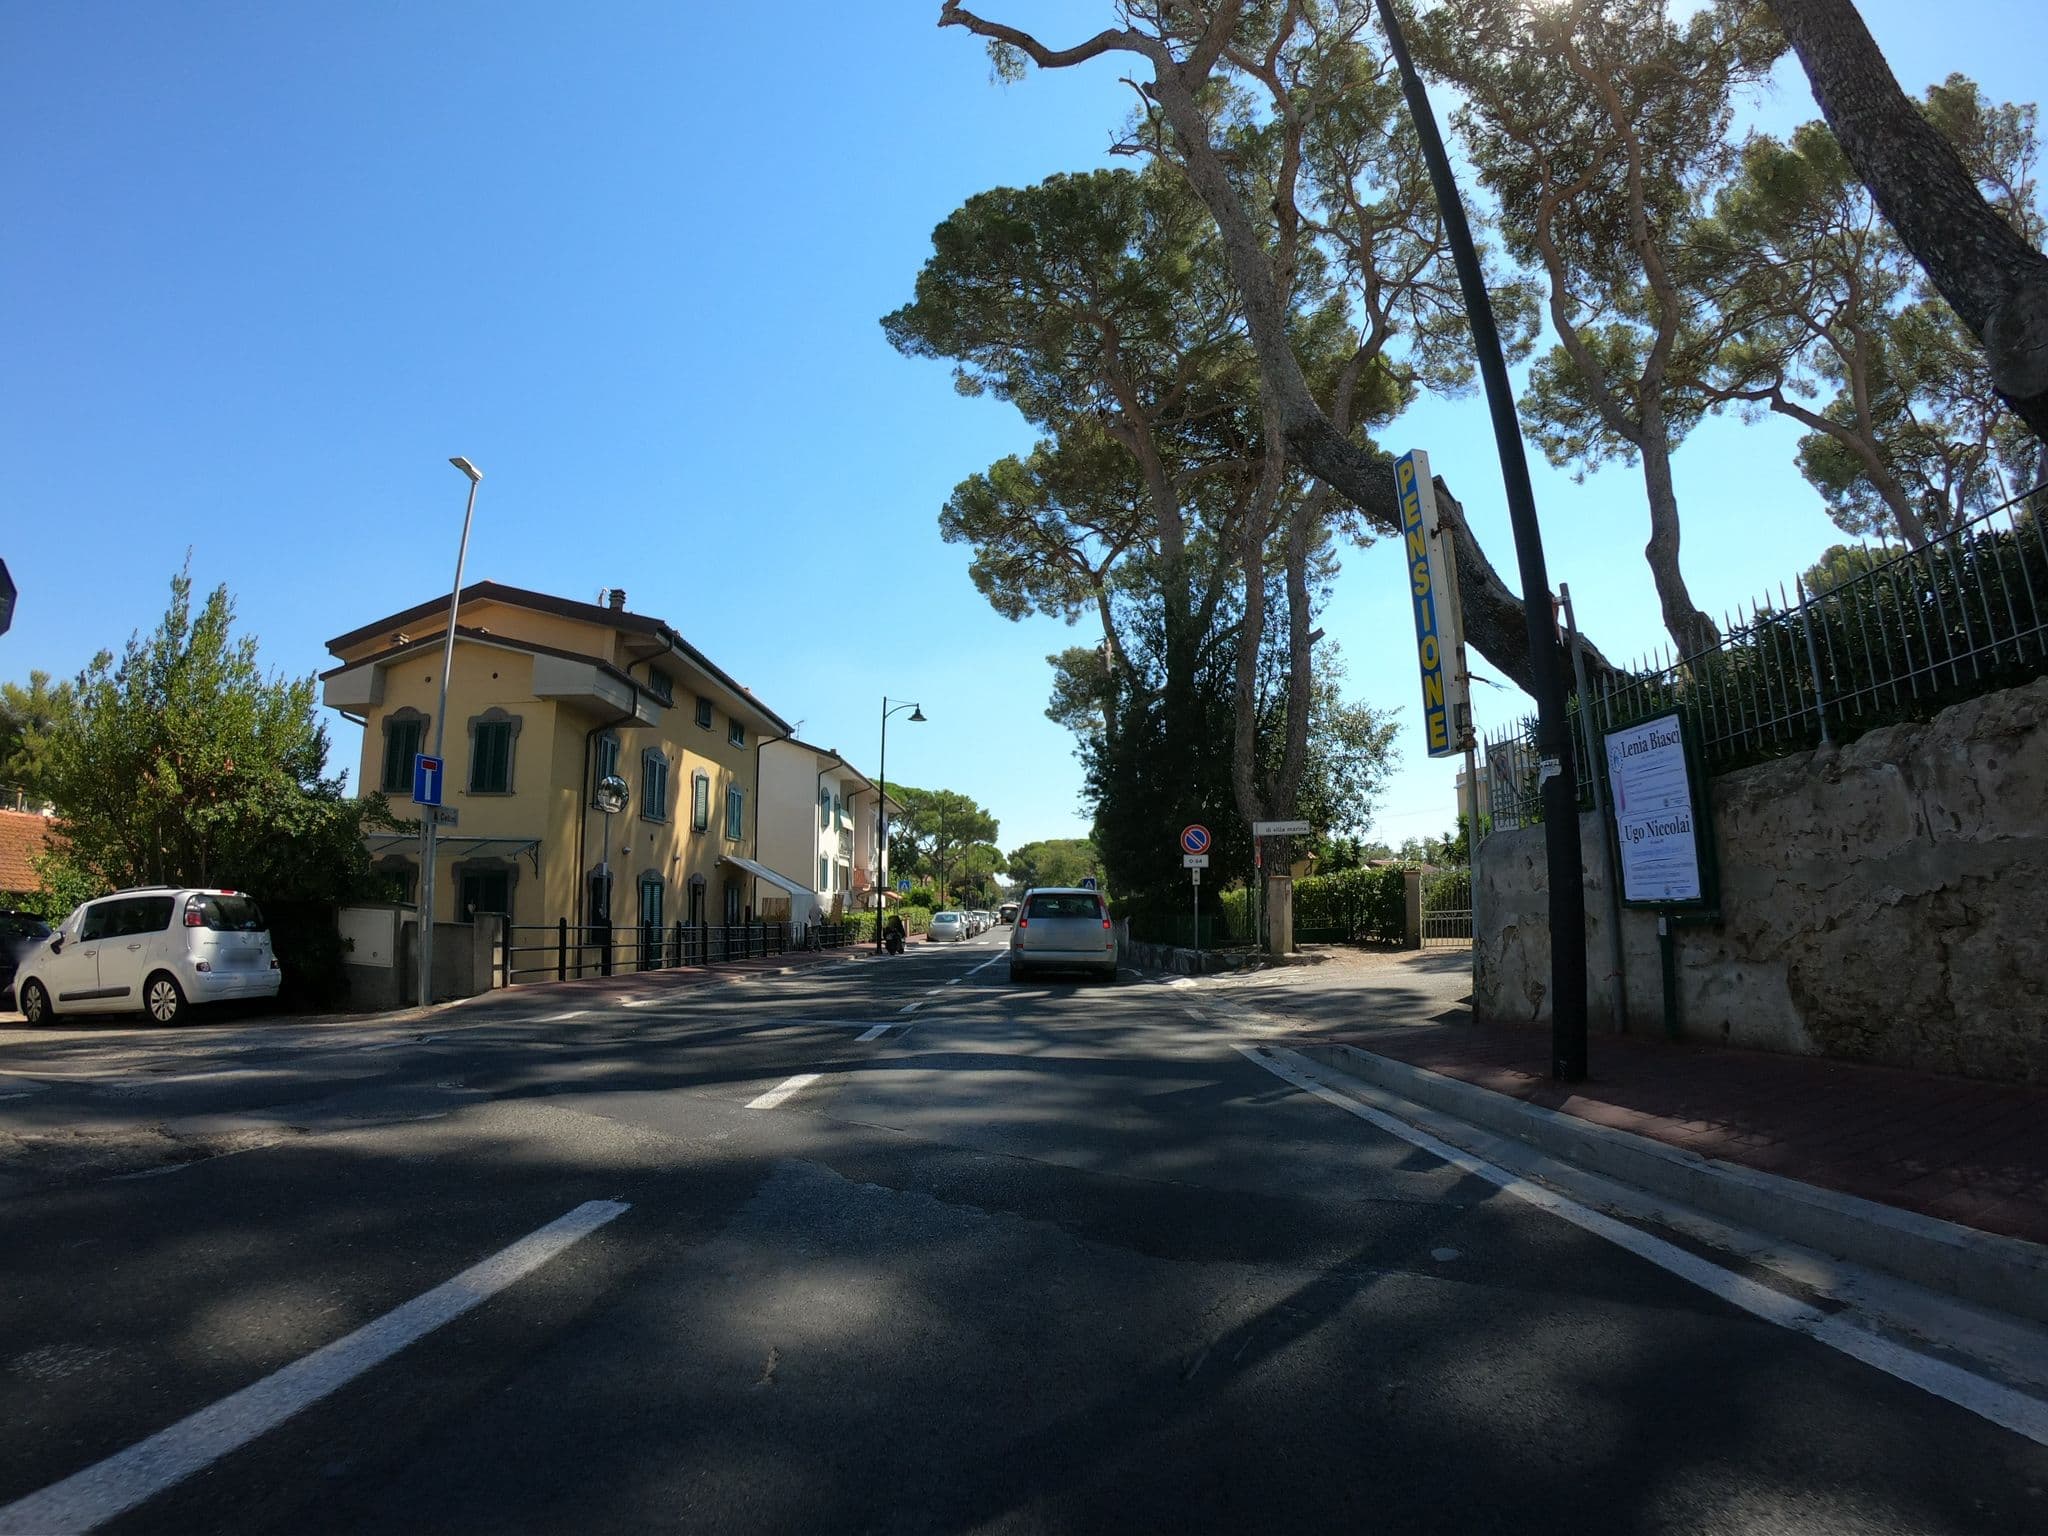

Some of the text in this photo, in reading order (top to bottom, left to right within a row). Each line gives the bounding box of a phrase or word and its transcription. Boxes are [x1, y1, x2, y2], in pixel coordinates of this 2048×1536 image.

[1397, 459, 1447, 749] PENSIONE
[1621, 736, 1649, 758] Lenia
[1649, 723, 1680, 750] Biasci
[1624, 824, 1645, 844] Ugo
[1646, 814, 1691, 838] Niccolai
